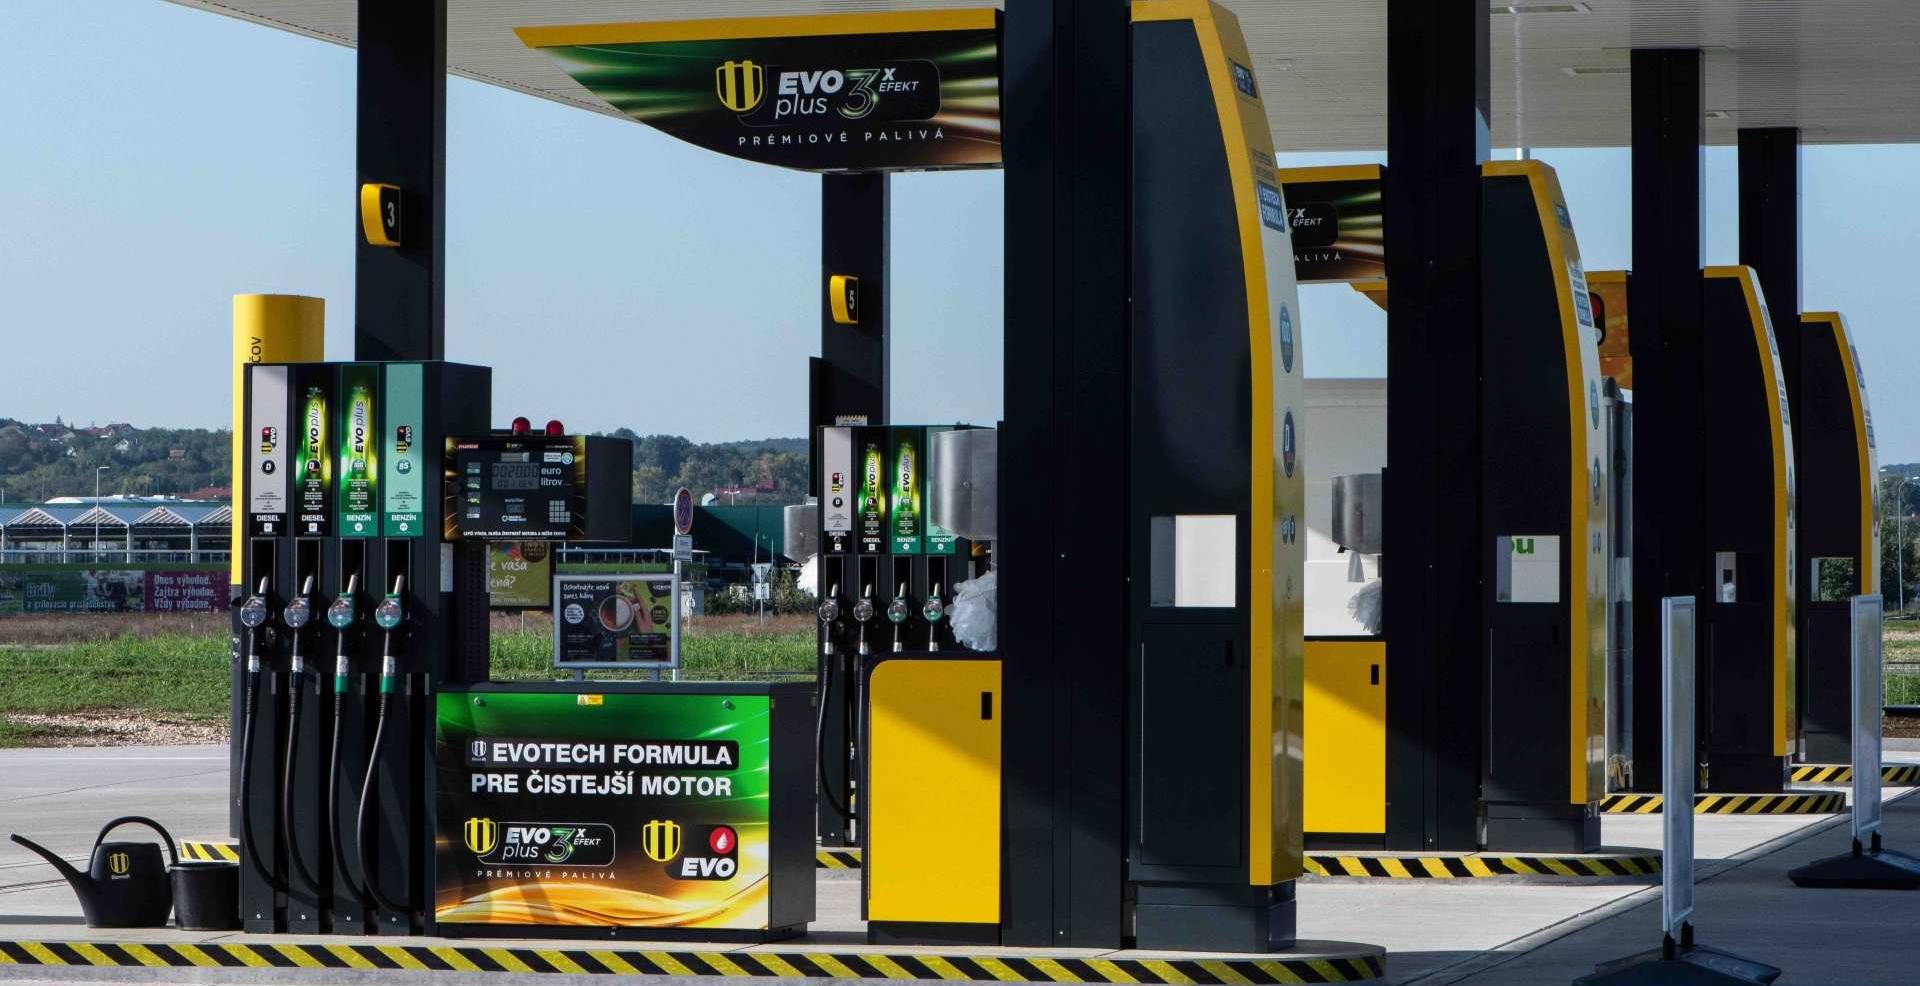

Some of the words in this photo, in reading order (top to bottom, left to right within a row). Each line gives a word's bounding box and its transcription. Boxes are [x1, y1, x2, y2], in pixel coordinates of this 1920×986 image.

[778, 70, 844, 95] EVO
[775, 95, 827, 119] plus
[879, 80, 919, 93] EFEKT
[738, 131, 849, 146] PRÉMIOVÉ
[864, 128, 945, 142] PALIVÁ
[387, 201, 395, 228] 3
[1292, 218, 1323, 226] EFEKT
[849, 290, 855, 310] 5
[310, 400, 319, 427] plus
[356, 400, 364, 427] plus
[310, 428, 319, 454] EVO
[355, 428, 364, 454] EVO
[540, 467, 562, 475] euro
[540, 477, 563, 486] litrov
[256, 514, 280, 522] DIESEL
[301, 514, 325, 522] DIESEL
[346, 513, 371, 522] BENZÍN
[391, 513, 417, 522] BENZÍN
[501, 558, 528, 571] vaša
[493, 742, 605, 763] EVOTECH
[613, 744, 733, 766] FORMULA
[471, 773, 519, 794] PRE
[526, 769, 634, 796] ČISTEJŠÍ
[642, 775, 732, 797] MOTOR
[505, 827, 551, 845] EVO
[502, 843, 539, 861] plus
[573, 837, 601, 847] EFEKT
[477, 869, 551, 879] PRÉMIOVÉ
[562, 871, 616, 880] PALIVÁ
[681, 857, 736, 878] EVO
